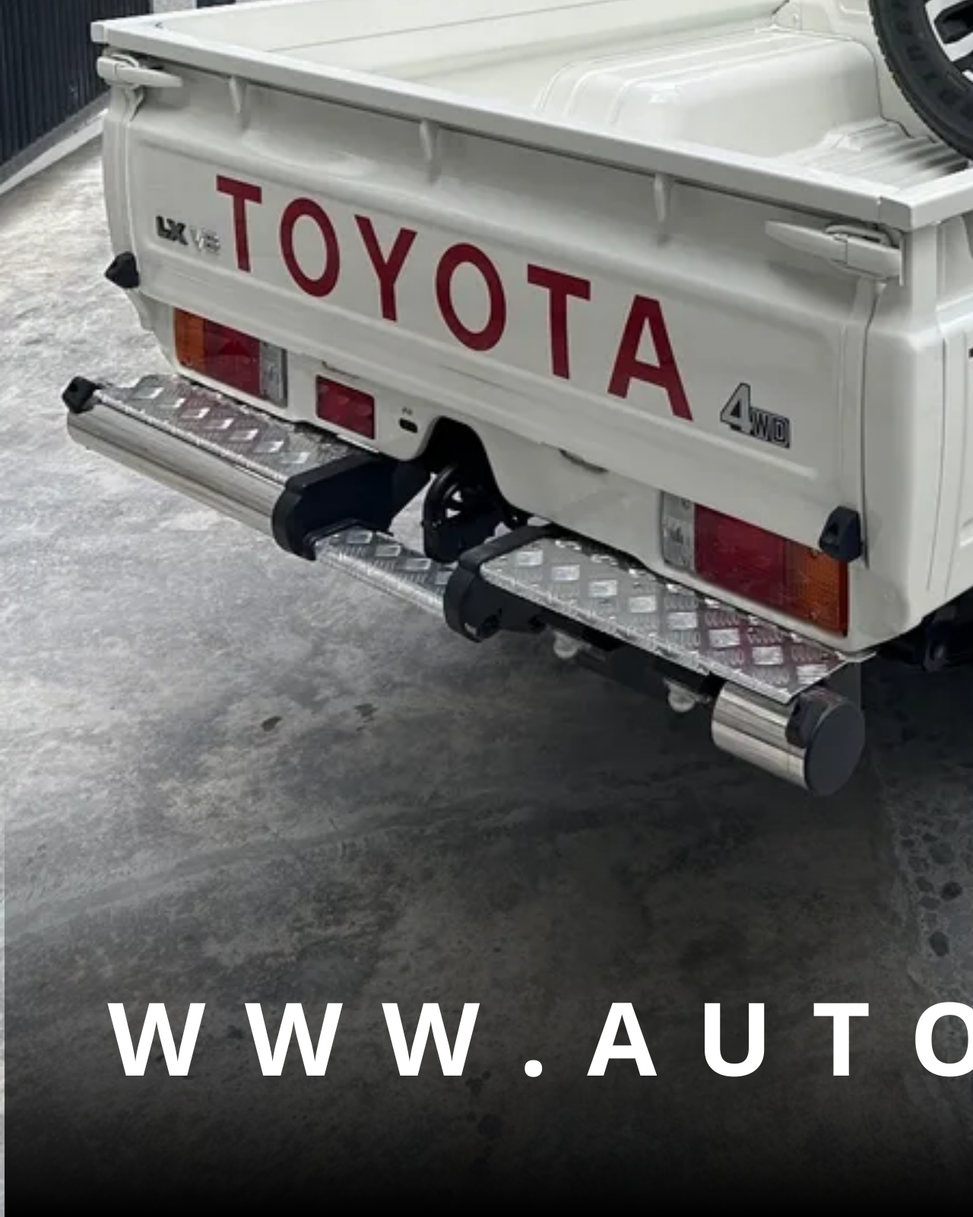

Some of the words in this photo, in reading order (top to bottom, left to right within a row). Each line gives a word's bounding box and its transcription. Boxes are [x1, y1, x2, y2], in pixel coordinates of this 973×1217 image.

[156, 215, 188, 246] LX
[216, 174, 693, 421] TOYOTA
[720, 382, 790, 449] 4WD
